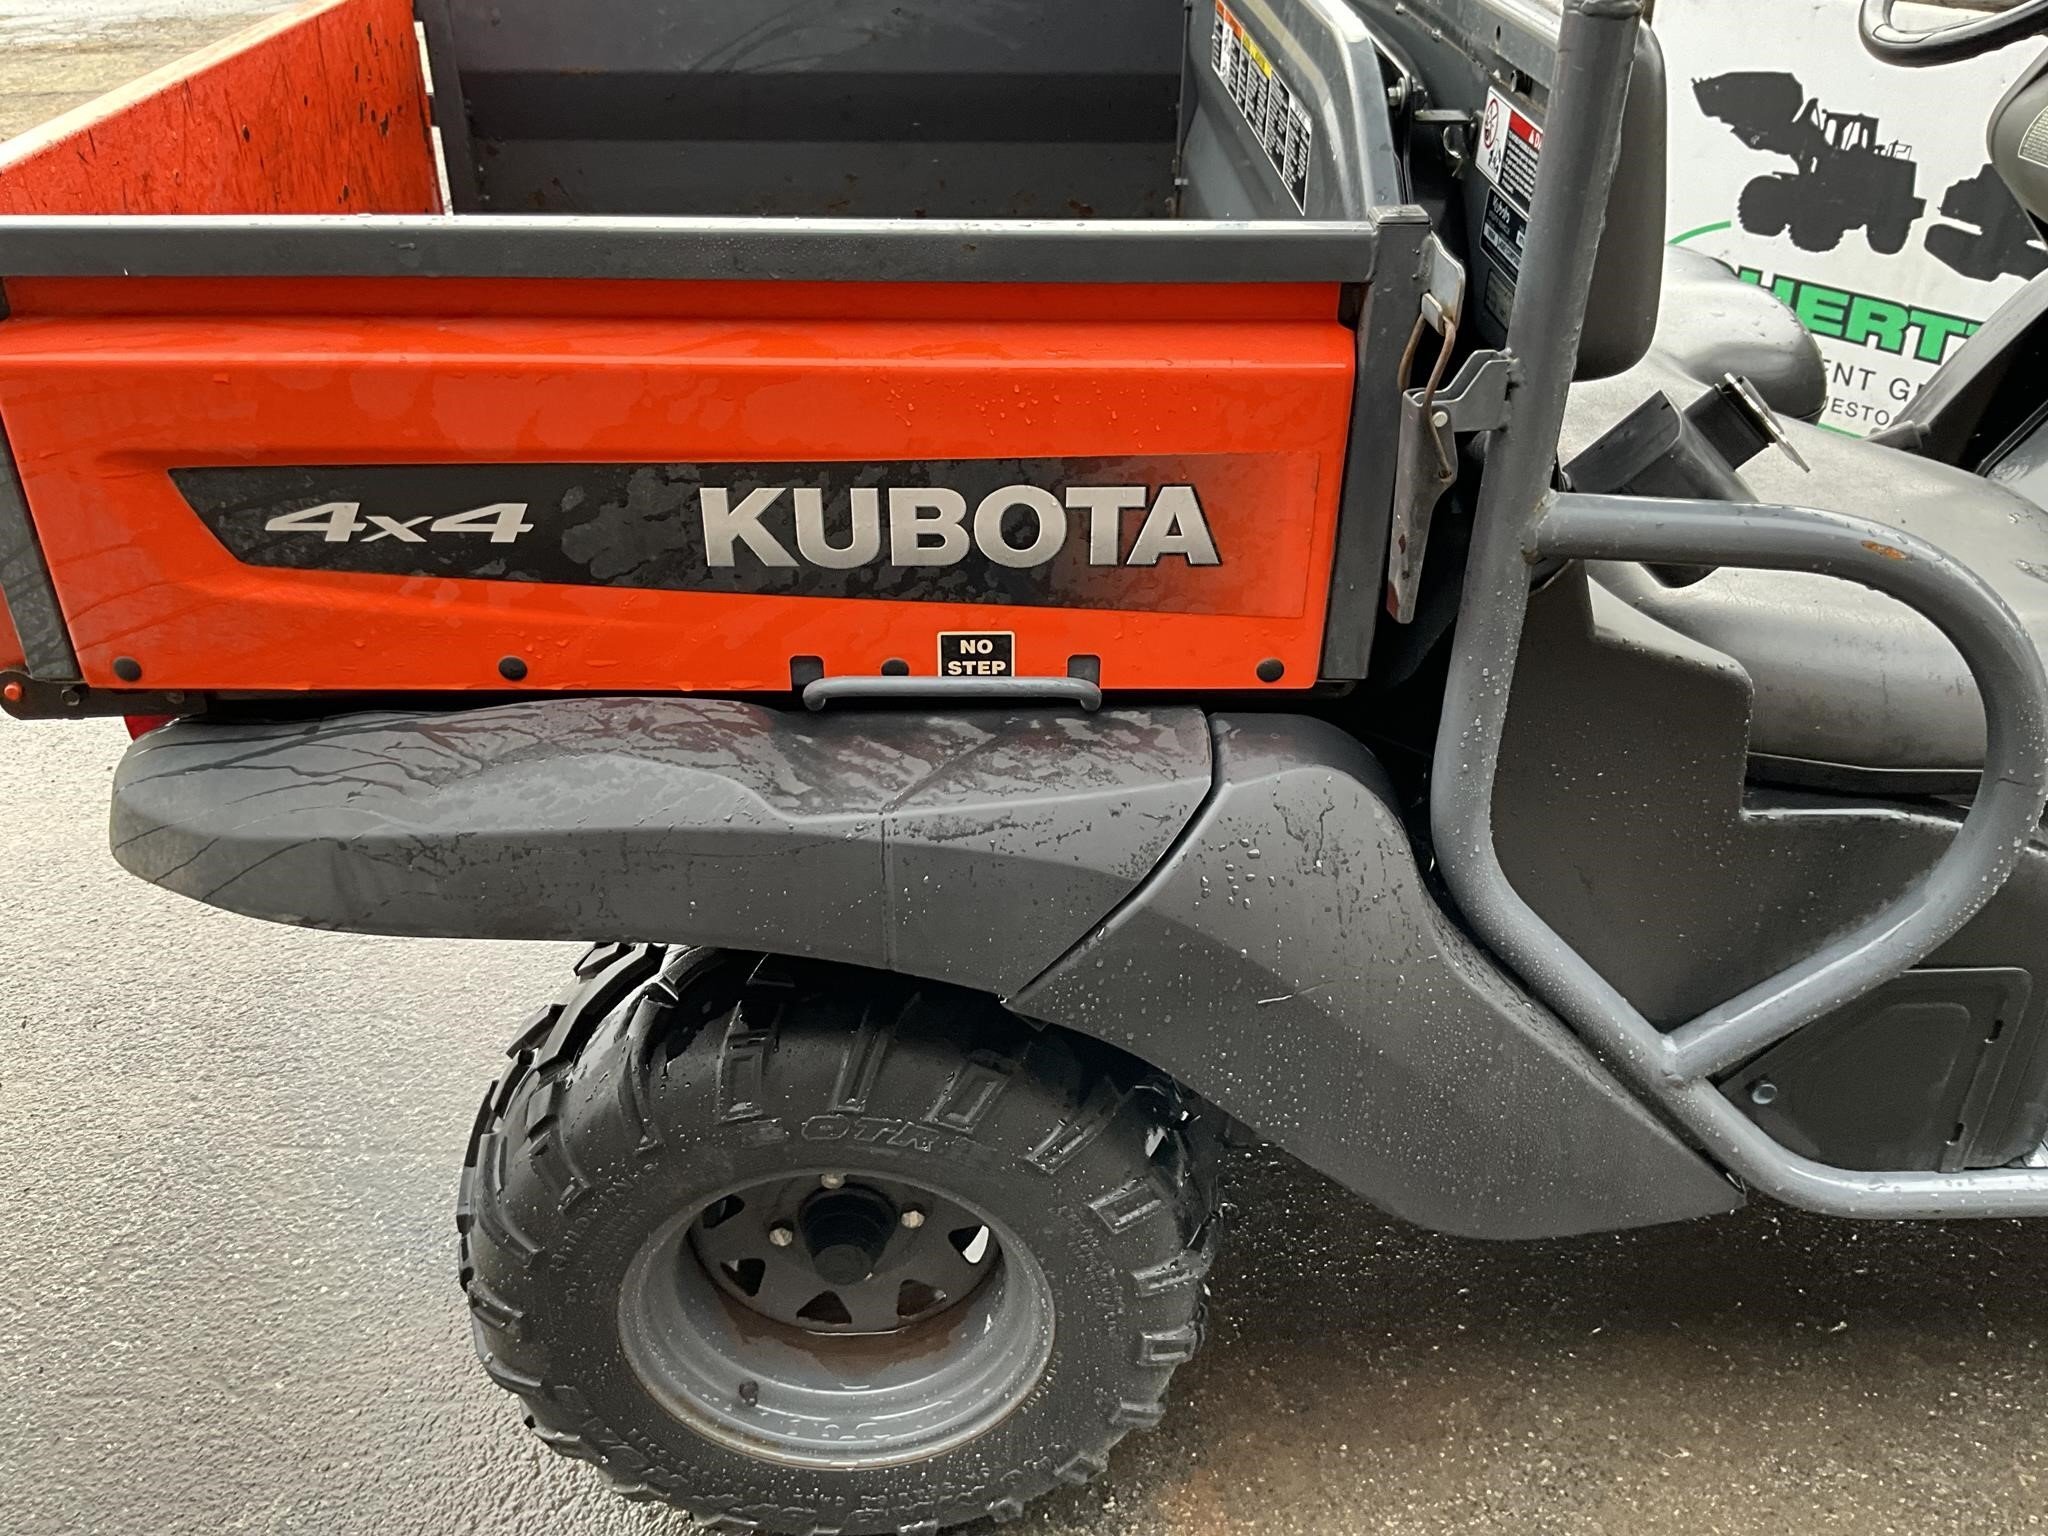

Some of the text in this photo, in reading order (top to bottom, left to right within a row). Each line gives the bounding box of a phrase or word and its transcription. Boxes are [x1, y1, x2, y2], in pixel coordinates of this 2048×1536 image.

[1737, 264, 1985, 366] ERT
[1823, 358, 1926, 403] NT G
[264, 484, 1221, 569] 4x4 KUBOTA
[947, 660, 1007, 676] STEP
[960, 639, 994, 654] NO
